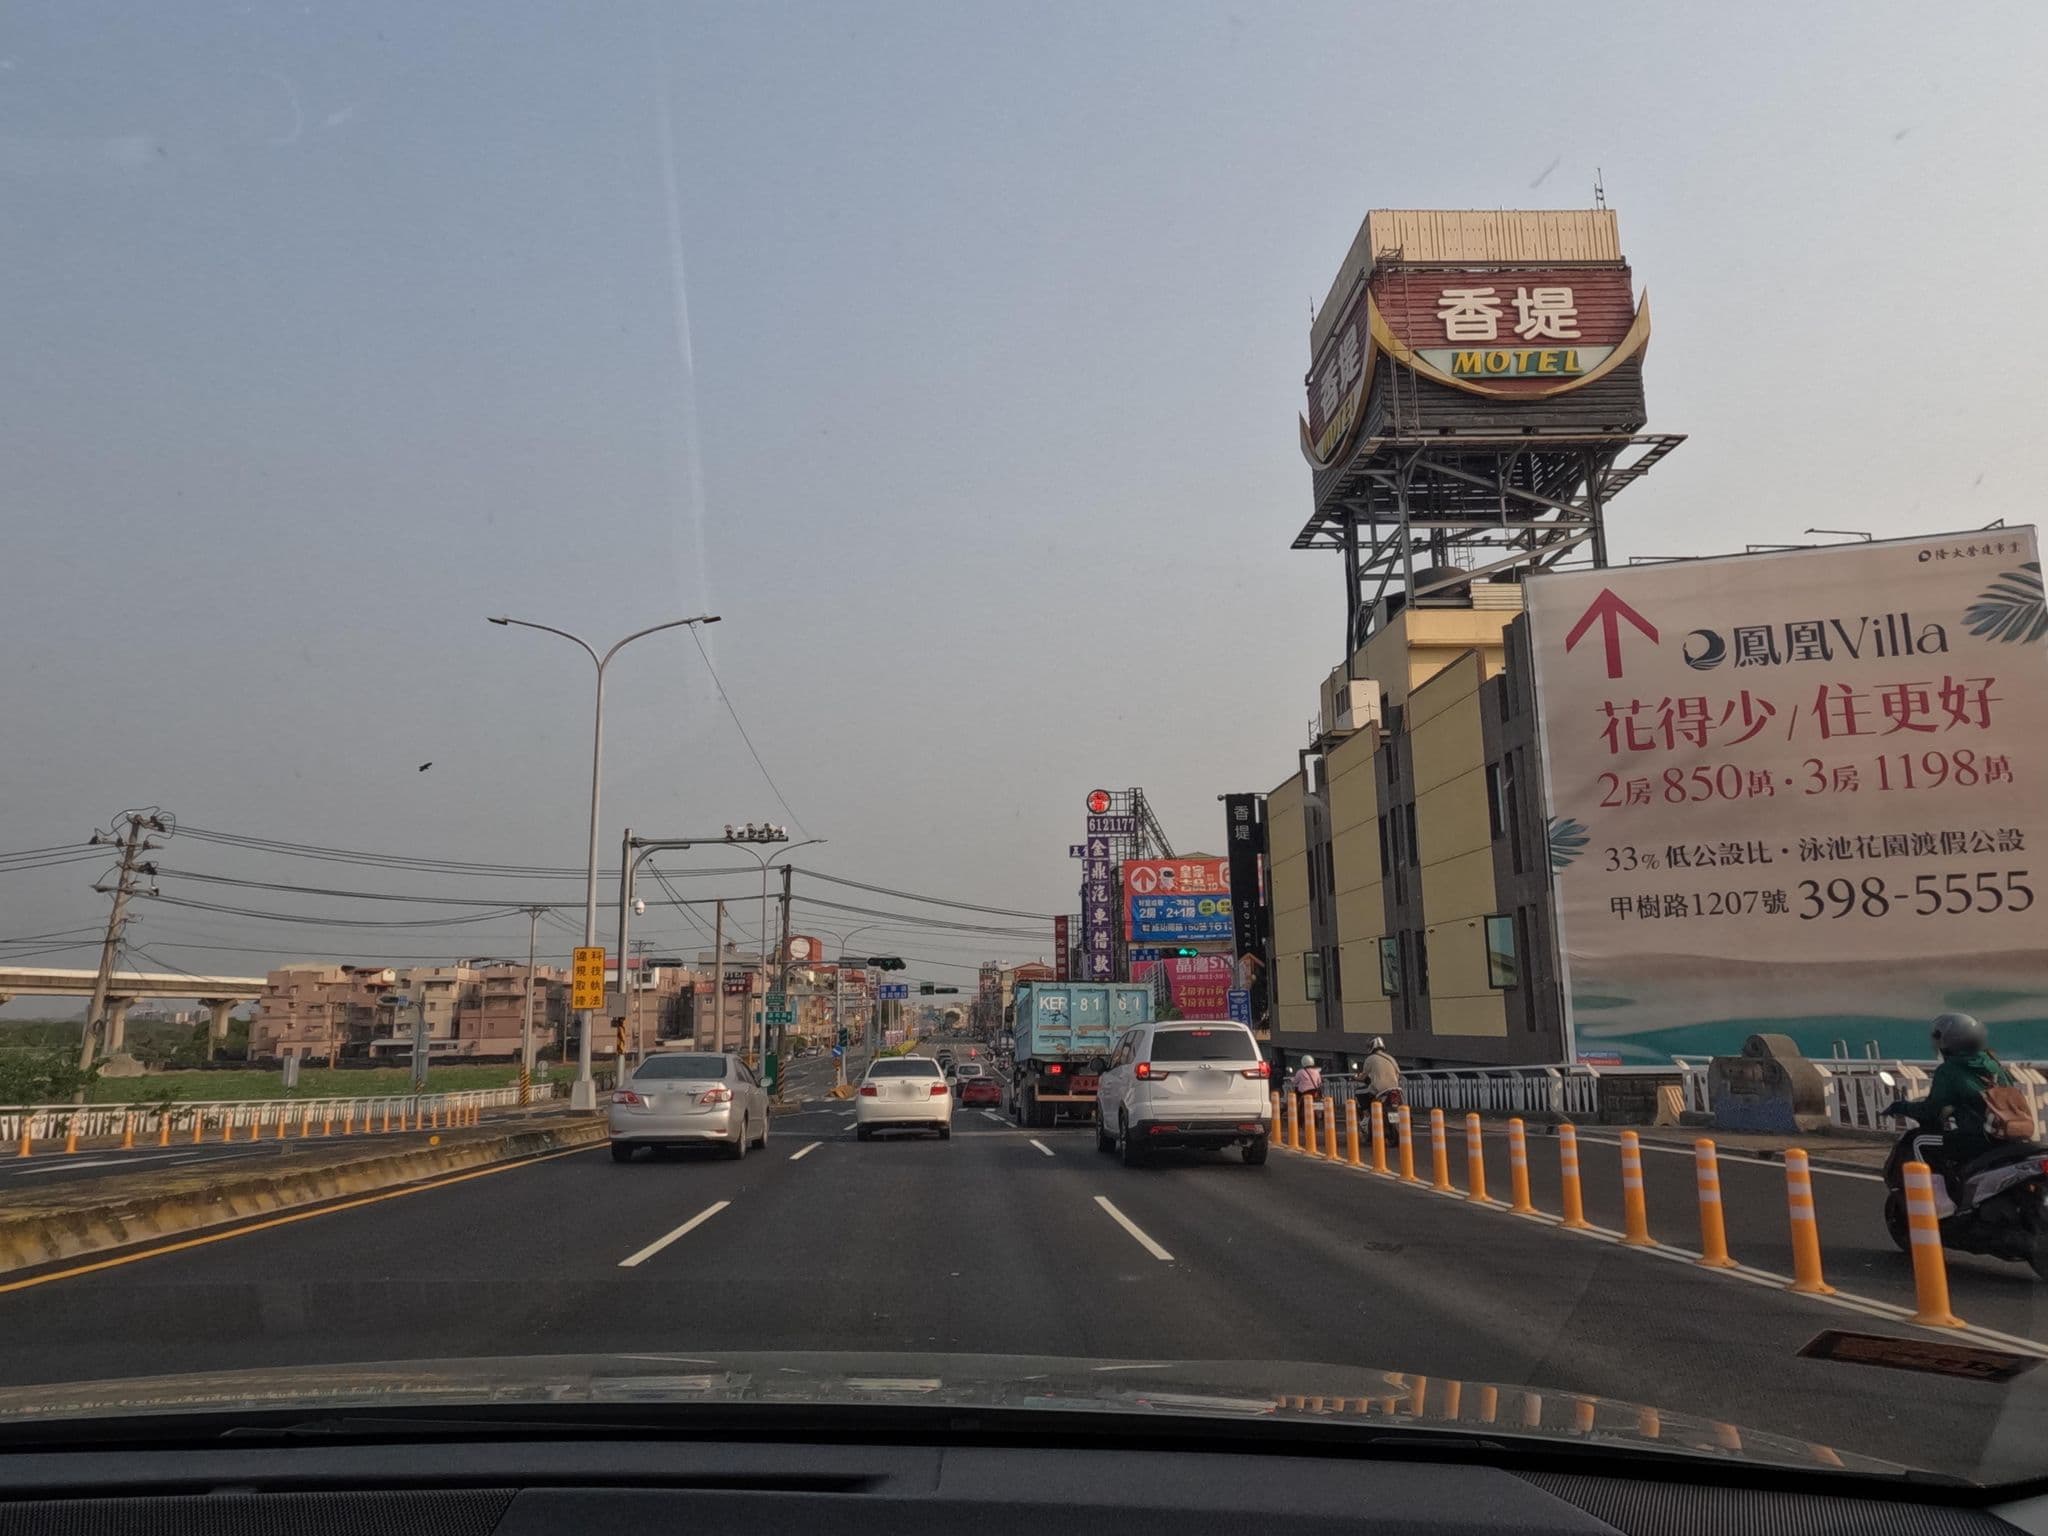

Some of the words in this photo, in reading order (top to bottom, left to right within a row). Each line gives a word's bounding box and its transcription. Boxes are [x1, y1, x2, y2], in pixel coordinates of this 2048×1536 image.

[1437, 287, 1581, 341] 香堤
[1320, 324, 1361, 424] 香堤
[1452, 350, 1584, 374] MOTEL
[1733, 612, 1949, 669] 鳳凰Villa
[1088, 818, 1136, 832] 6121177
[1233, 805, 1249, 841] 香堤
[1610, 888, 1790, 921] 甲樹路1207號
[1797, 871, 2034, 920] 398-5555
